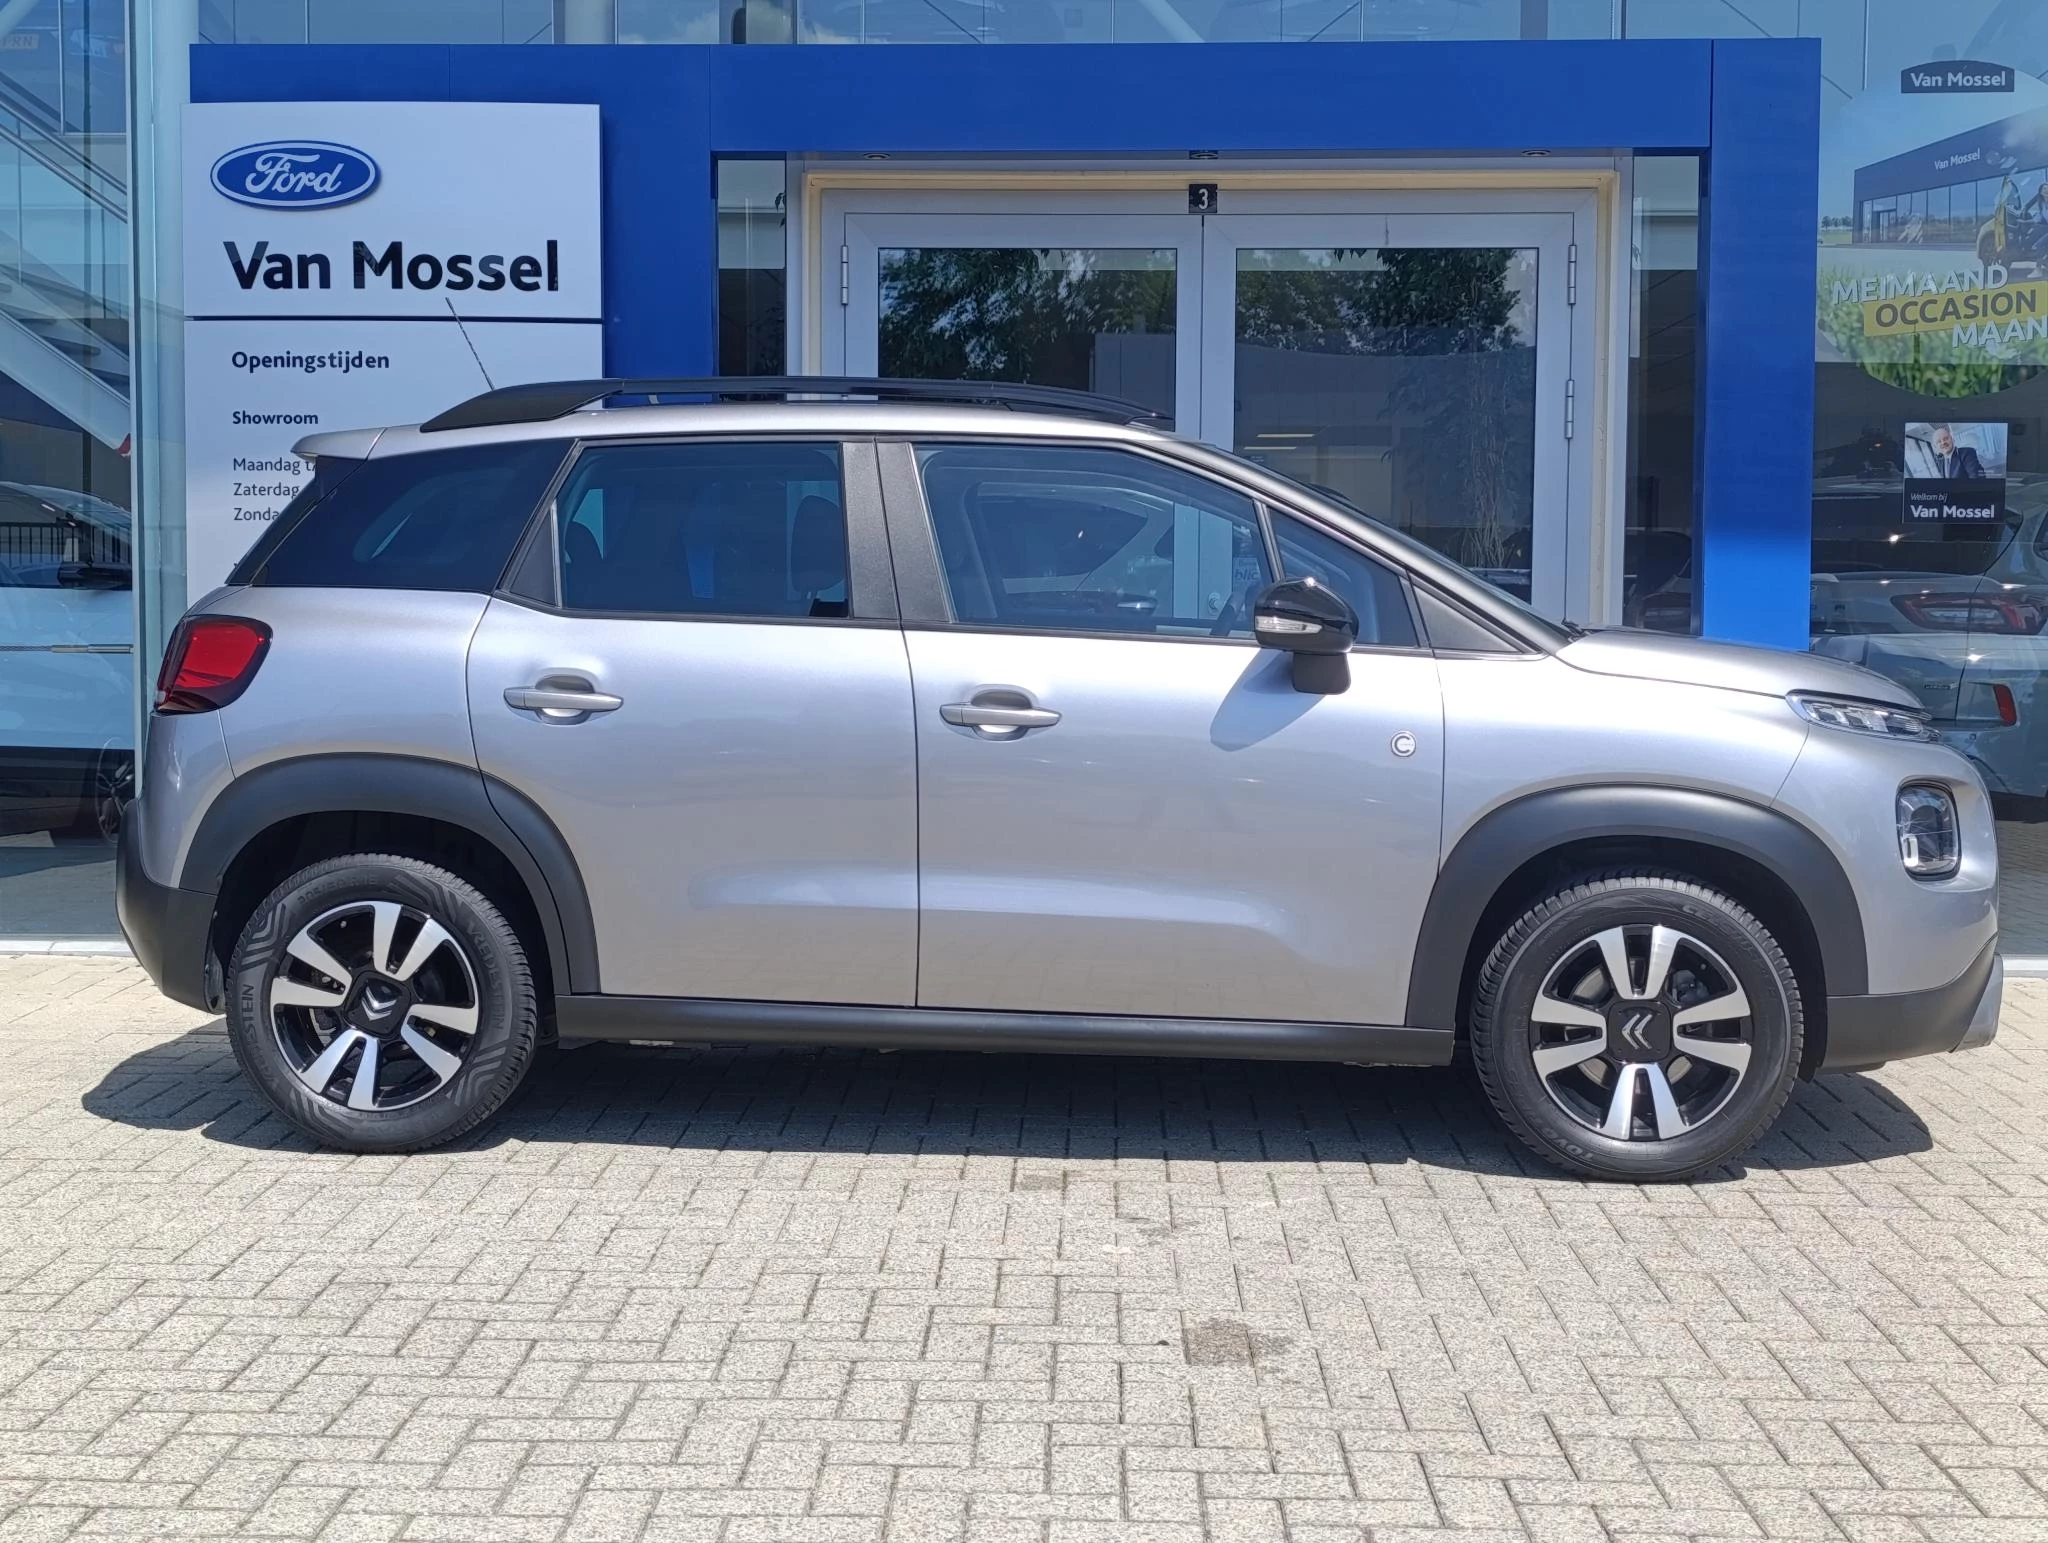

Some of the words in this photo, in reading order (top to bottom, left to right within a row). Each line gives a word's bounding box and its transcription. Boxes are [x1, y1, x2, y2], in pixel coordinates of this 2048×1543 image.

[1910, 73, 1941, 87] Van
[1947, 71, 2006, 87] Mossel
[1934, 160, 1949, 170] Van
[1950, 148, 1980, 166] Mossel
[245, 152, 344, 193] Ford
[1198, 188, 1209, 210] 3
[223, 241, 331, 290] Van
[353, 240, 558, 291] Mossel
[1832, 265, 2009, 305] MEIMAAND
[1875, 289, 2037, 328] OCCASION
[1952, 316, 2048, 348] MAAN
[231, 351, 390, 374] Openingstijden
[232, 410, 319, 425] Showroom
[233, 457, 301, 476] Maandag
[233, 482, 300, 500] Zaterdag
[1910, 493, 1938, 501] Welkom
[1938, 493, 1948, 503] bij
[233, 507, 281, 521] Zonda
[1910, 505, 1939, 518] Van
[1943, 504, 1995, 518] Mossel
